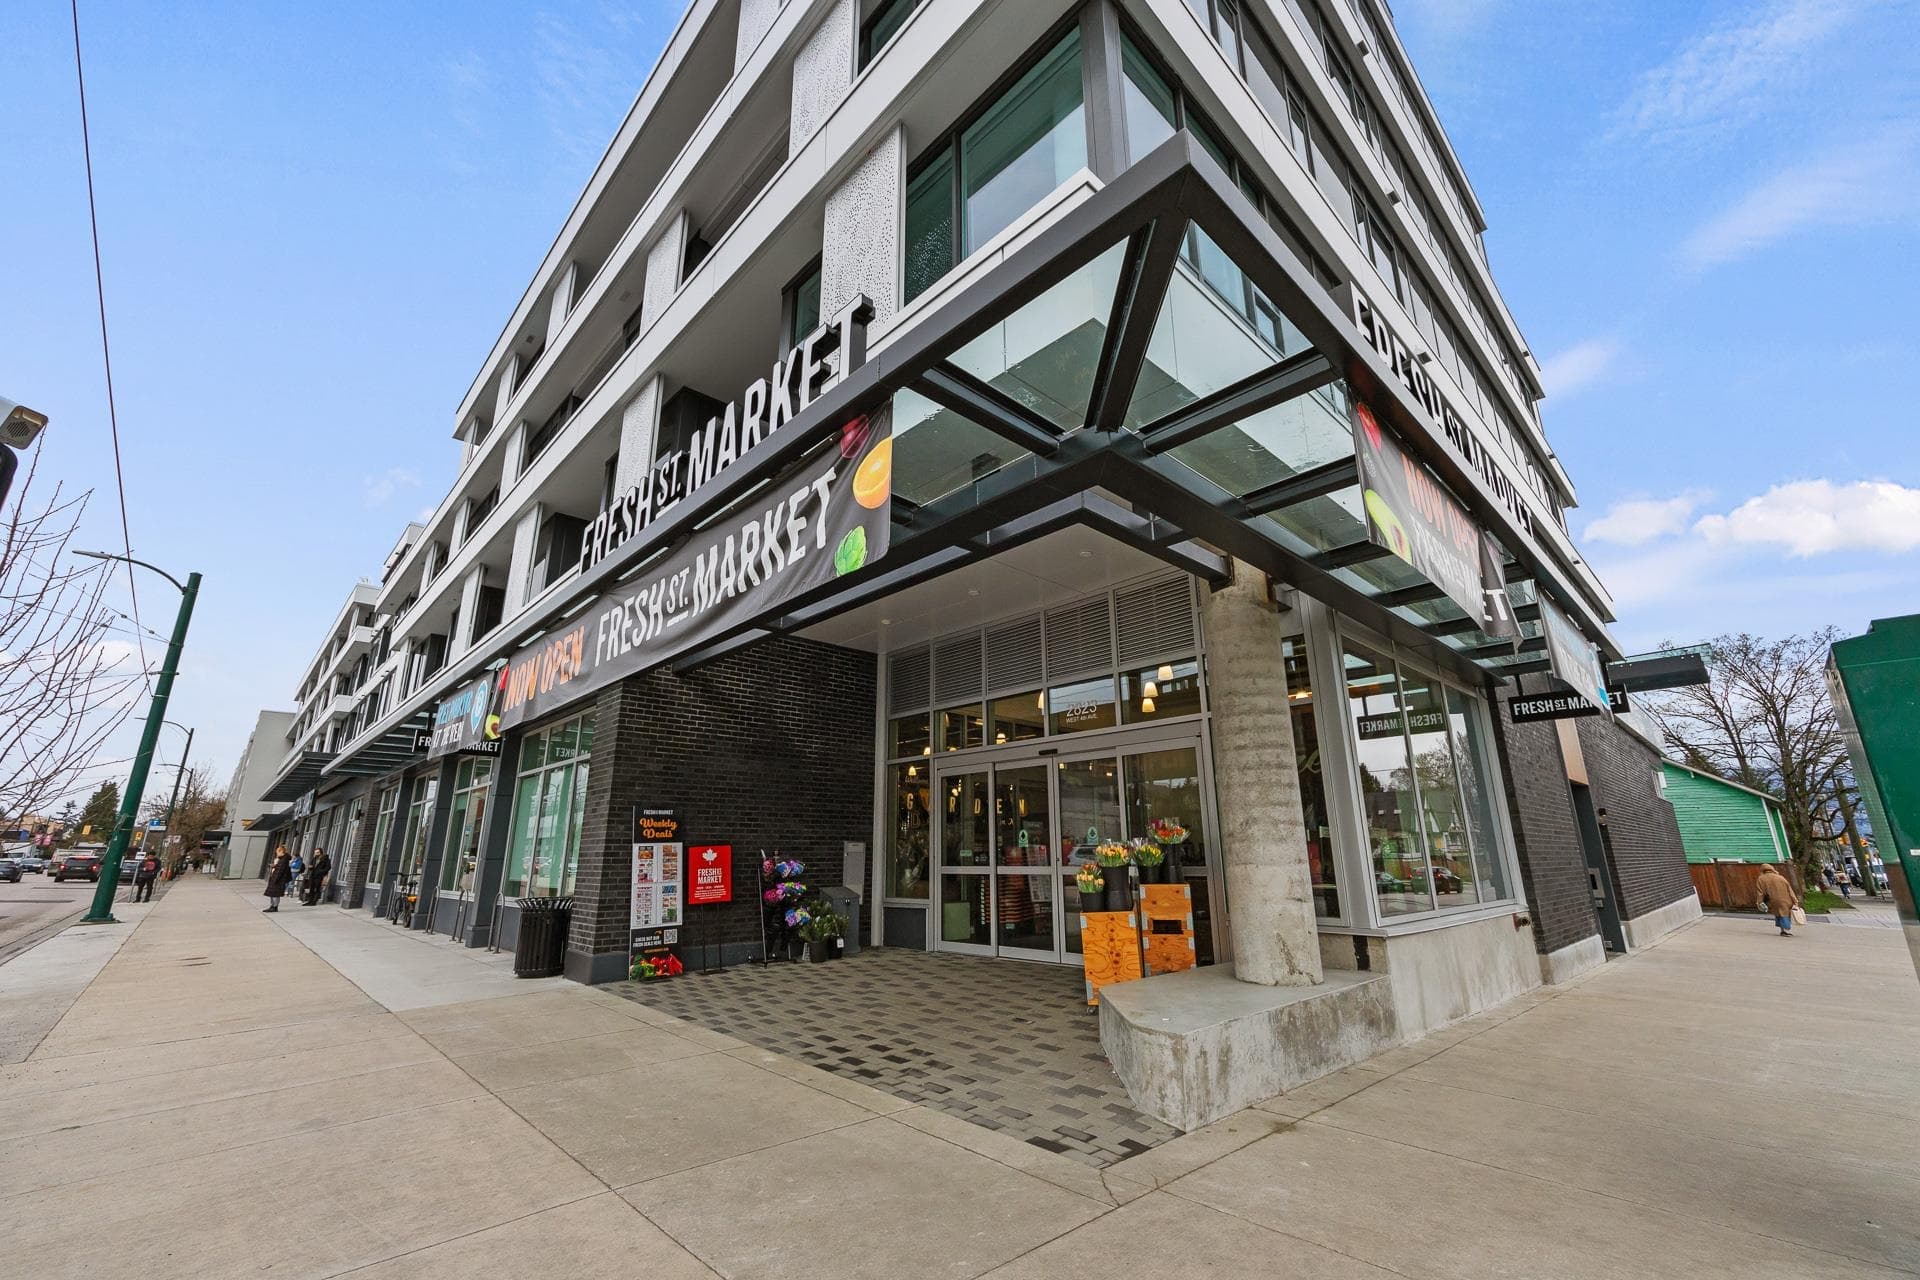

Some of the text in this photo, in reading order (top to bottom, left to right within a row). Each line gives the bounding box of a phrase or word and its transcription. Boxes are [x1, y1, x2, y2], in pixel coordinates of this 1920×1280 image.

[579, 293, 873, 576] FRESH ST. MARKET
[504, 466, 838, 712] NOW OPEN FRESH ST. MARKET
[1513, 700, 1555, 716] FRESH
[1568, 692, 1622, 710] MAET
[640, 818, 677, 830] Weekly
[643, 828, 672, 838] Deals
[698, 868, 716, 876] FRESH
[698, 875, 722, 884] MARKET
